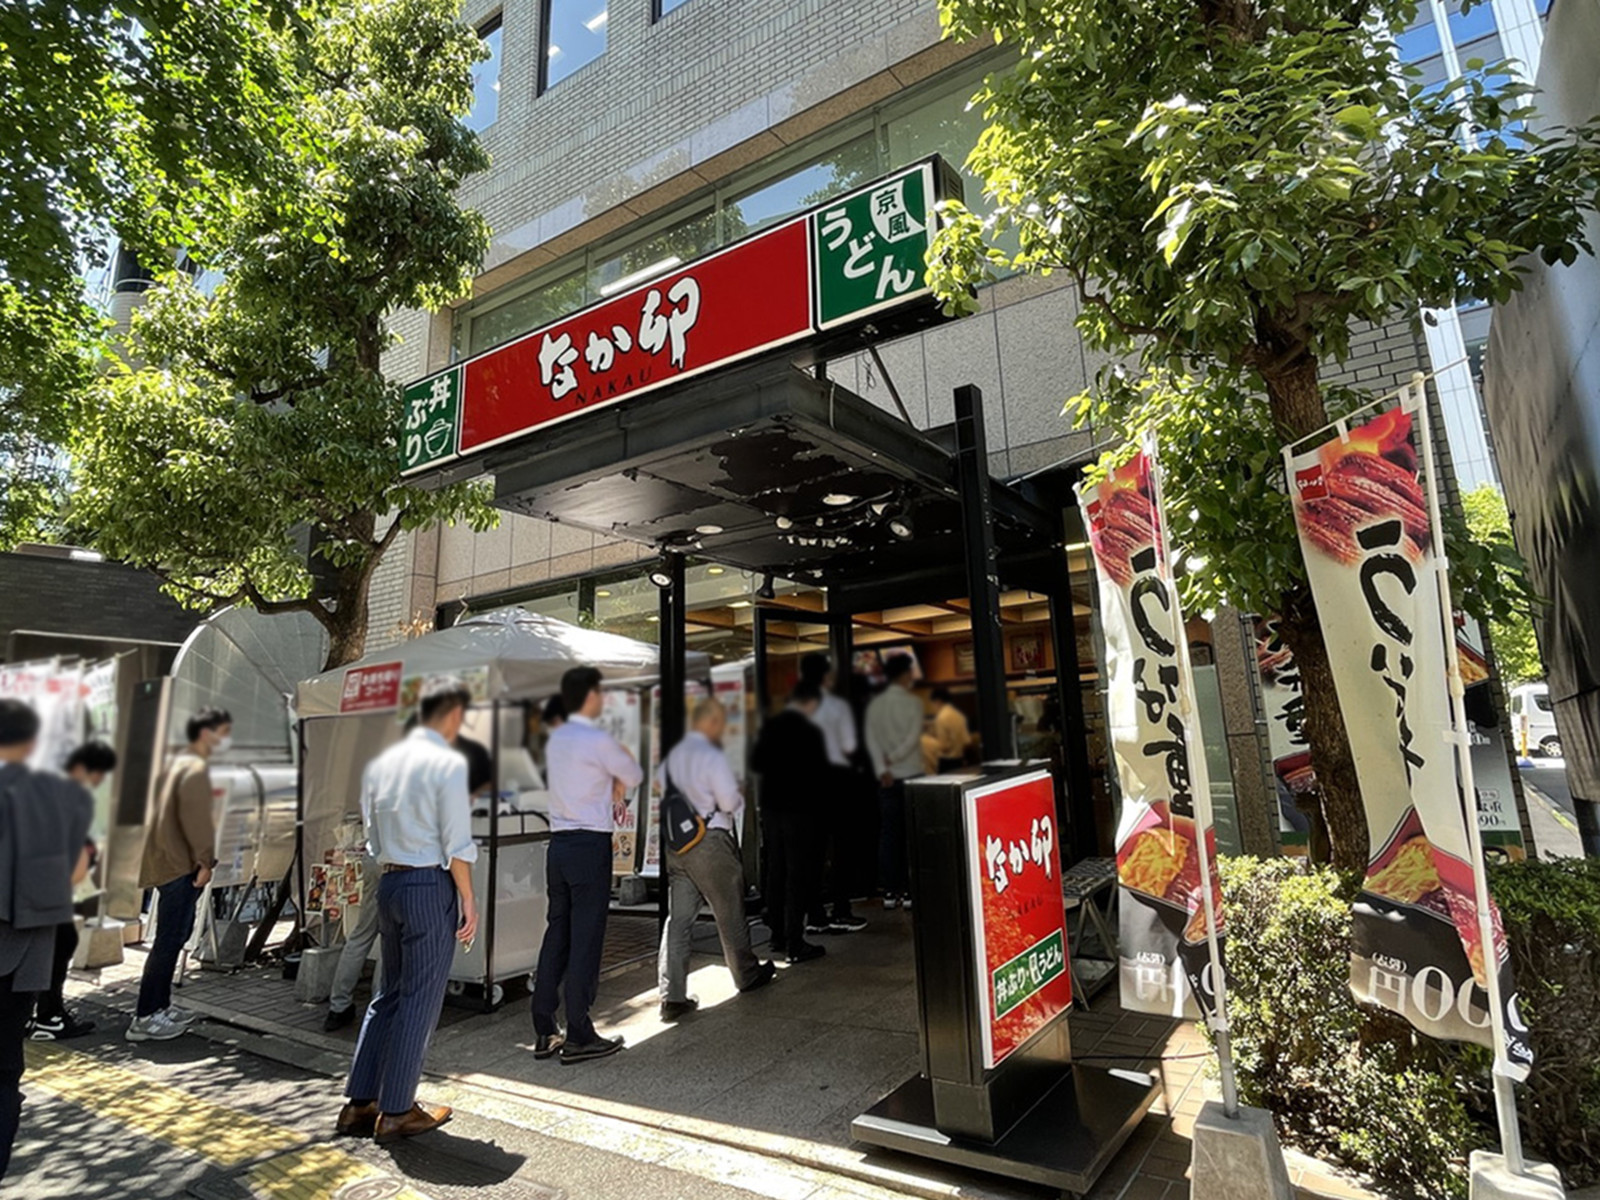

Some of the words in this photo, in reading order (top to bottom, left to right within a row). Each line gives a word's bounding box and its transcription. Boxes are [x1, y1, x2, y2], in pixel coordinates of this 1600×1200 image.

[876, 185, 911, 236] 京風
[821, 208, 916, 300] うどん
[536, 275, 702, 400] なか卯
[402, 375, 452, 467] 丼ぶり
[574, 367, 654, 406] NAKAU
[985, 814, 1053, 894] なか卯
